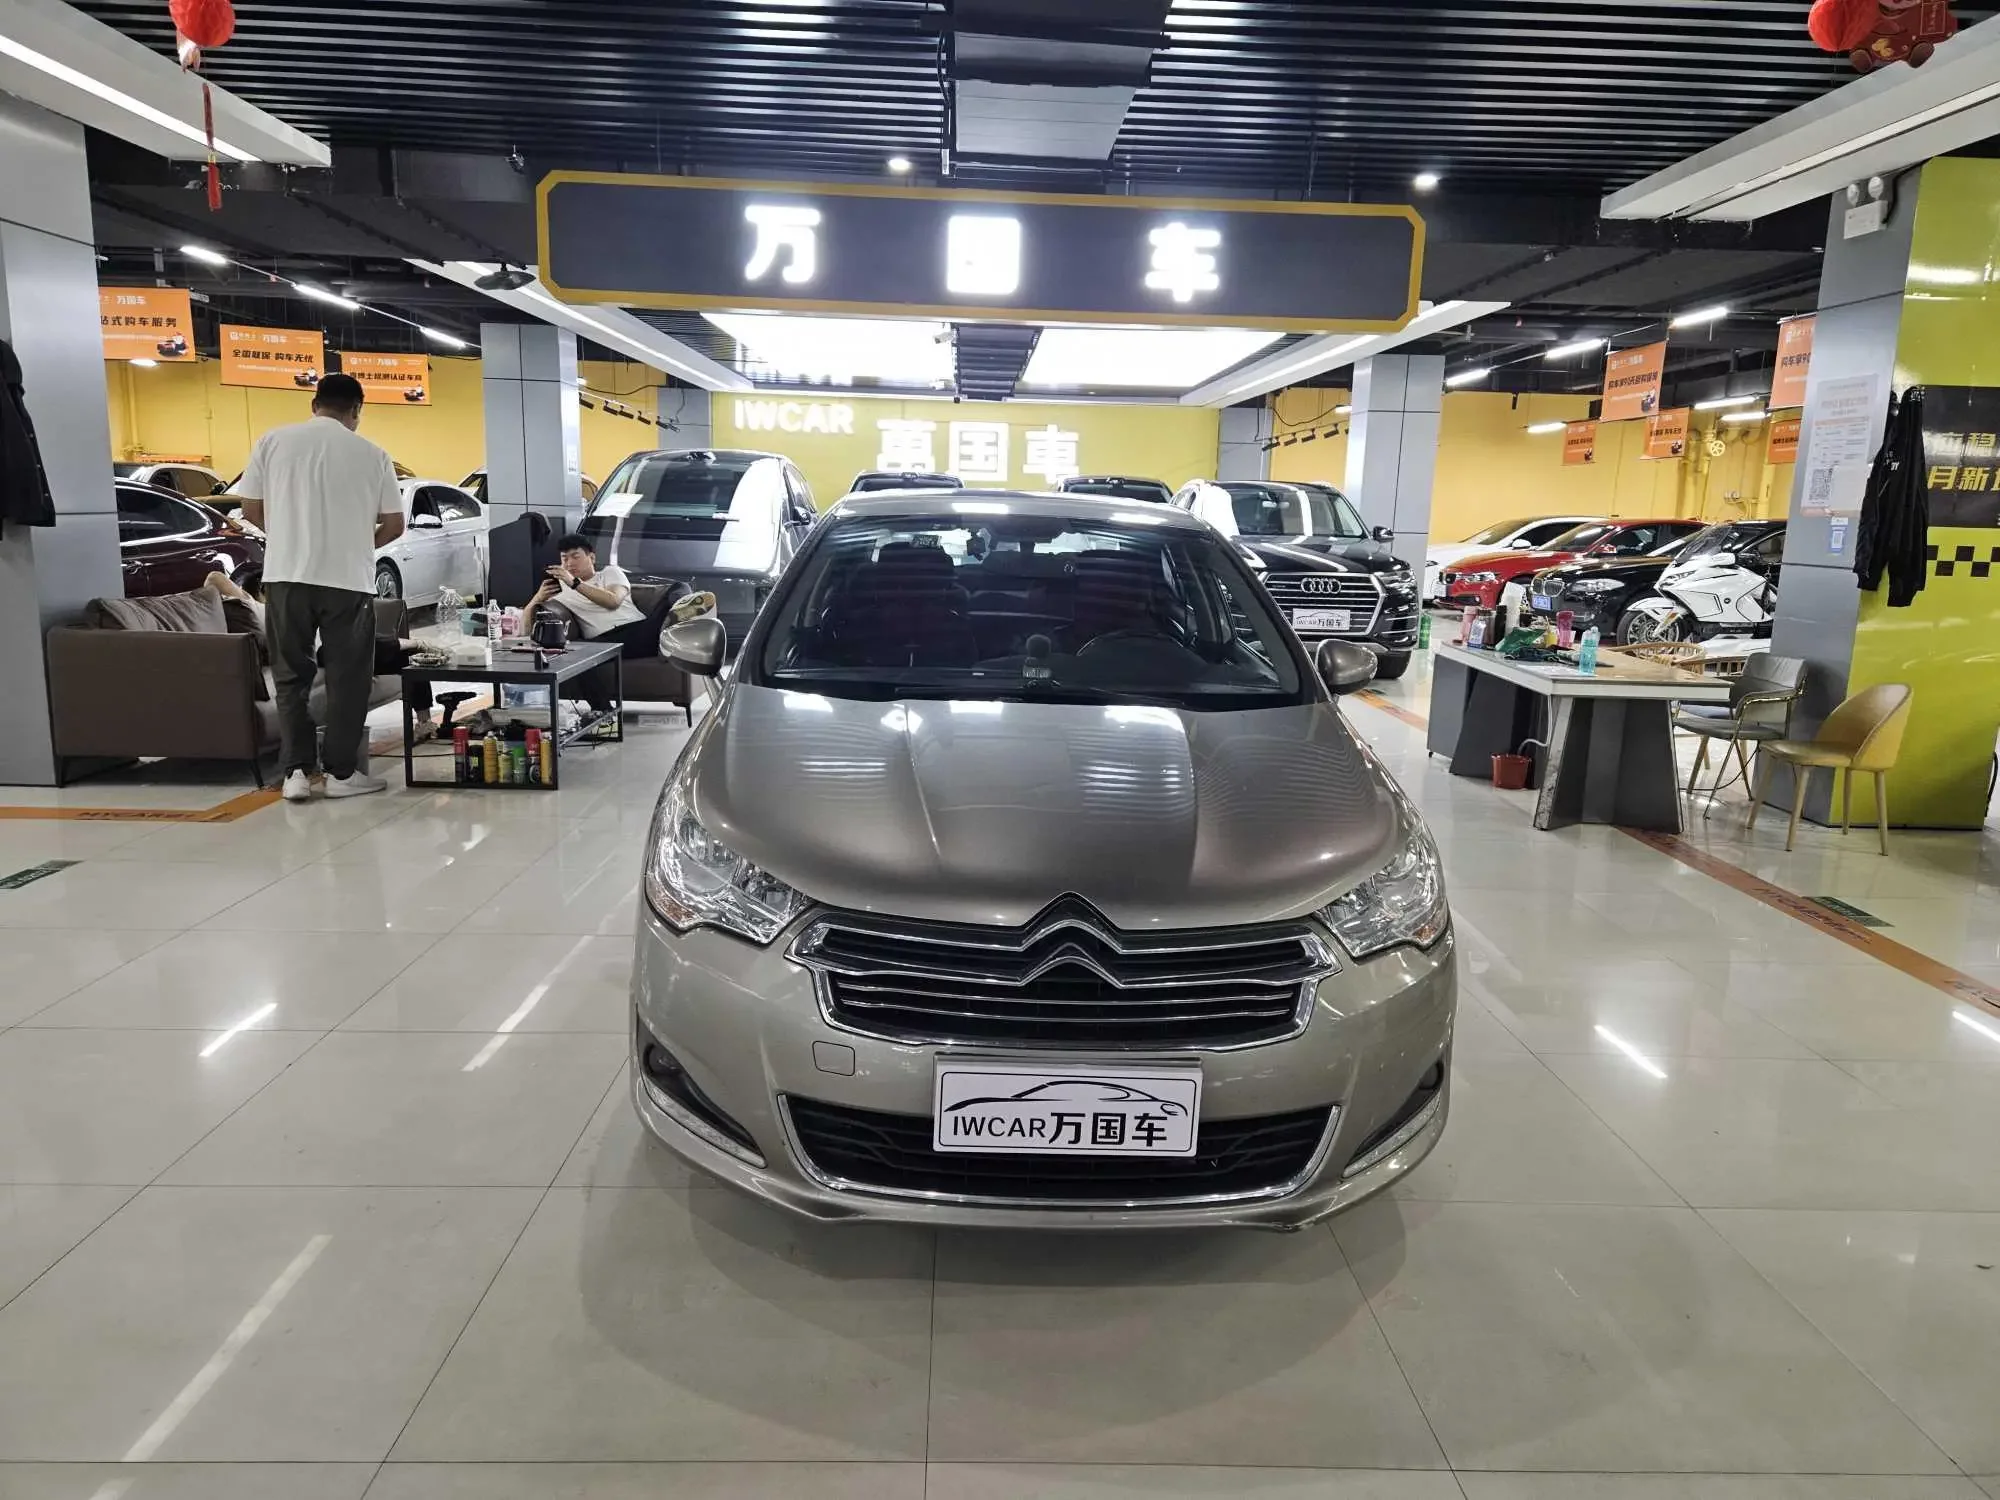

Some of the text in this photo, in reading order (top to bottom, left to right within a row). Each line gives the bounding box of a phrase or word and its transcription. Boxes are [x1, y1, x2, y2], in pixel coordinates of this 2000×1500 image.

[744, 203, 1222, 303] 万国车
[734, 399, 855, 434] IWCAR
